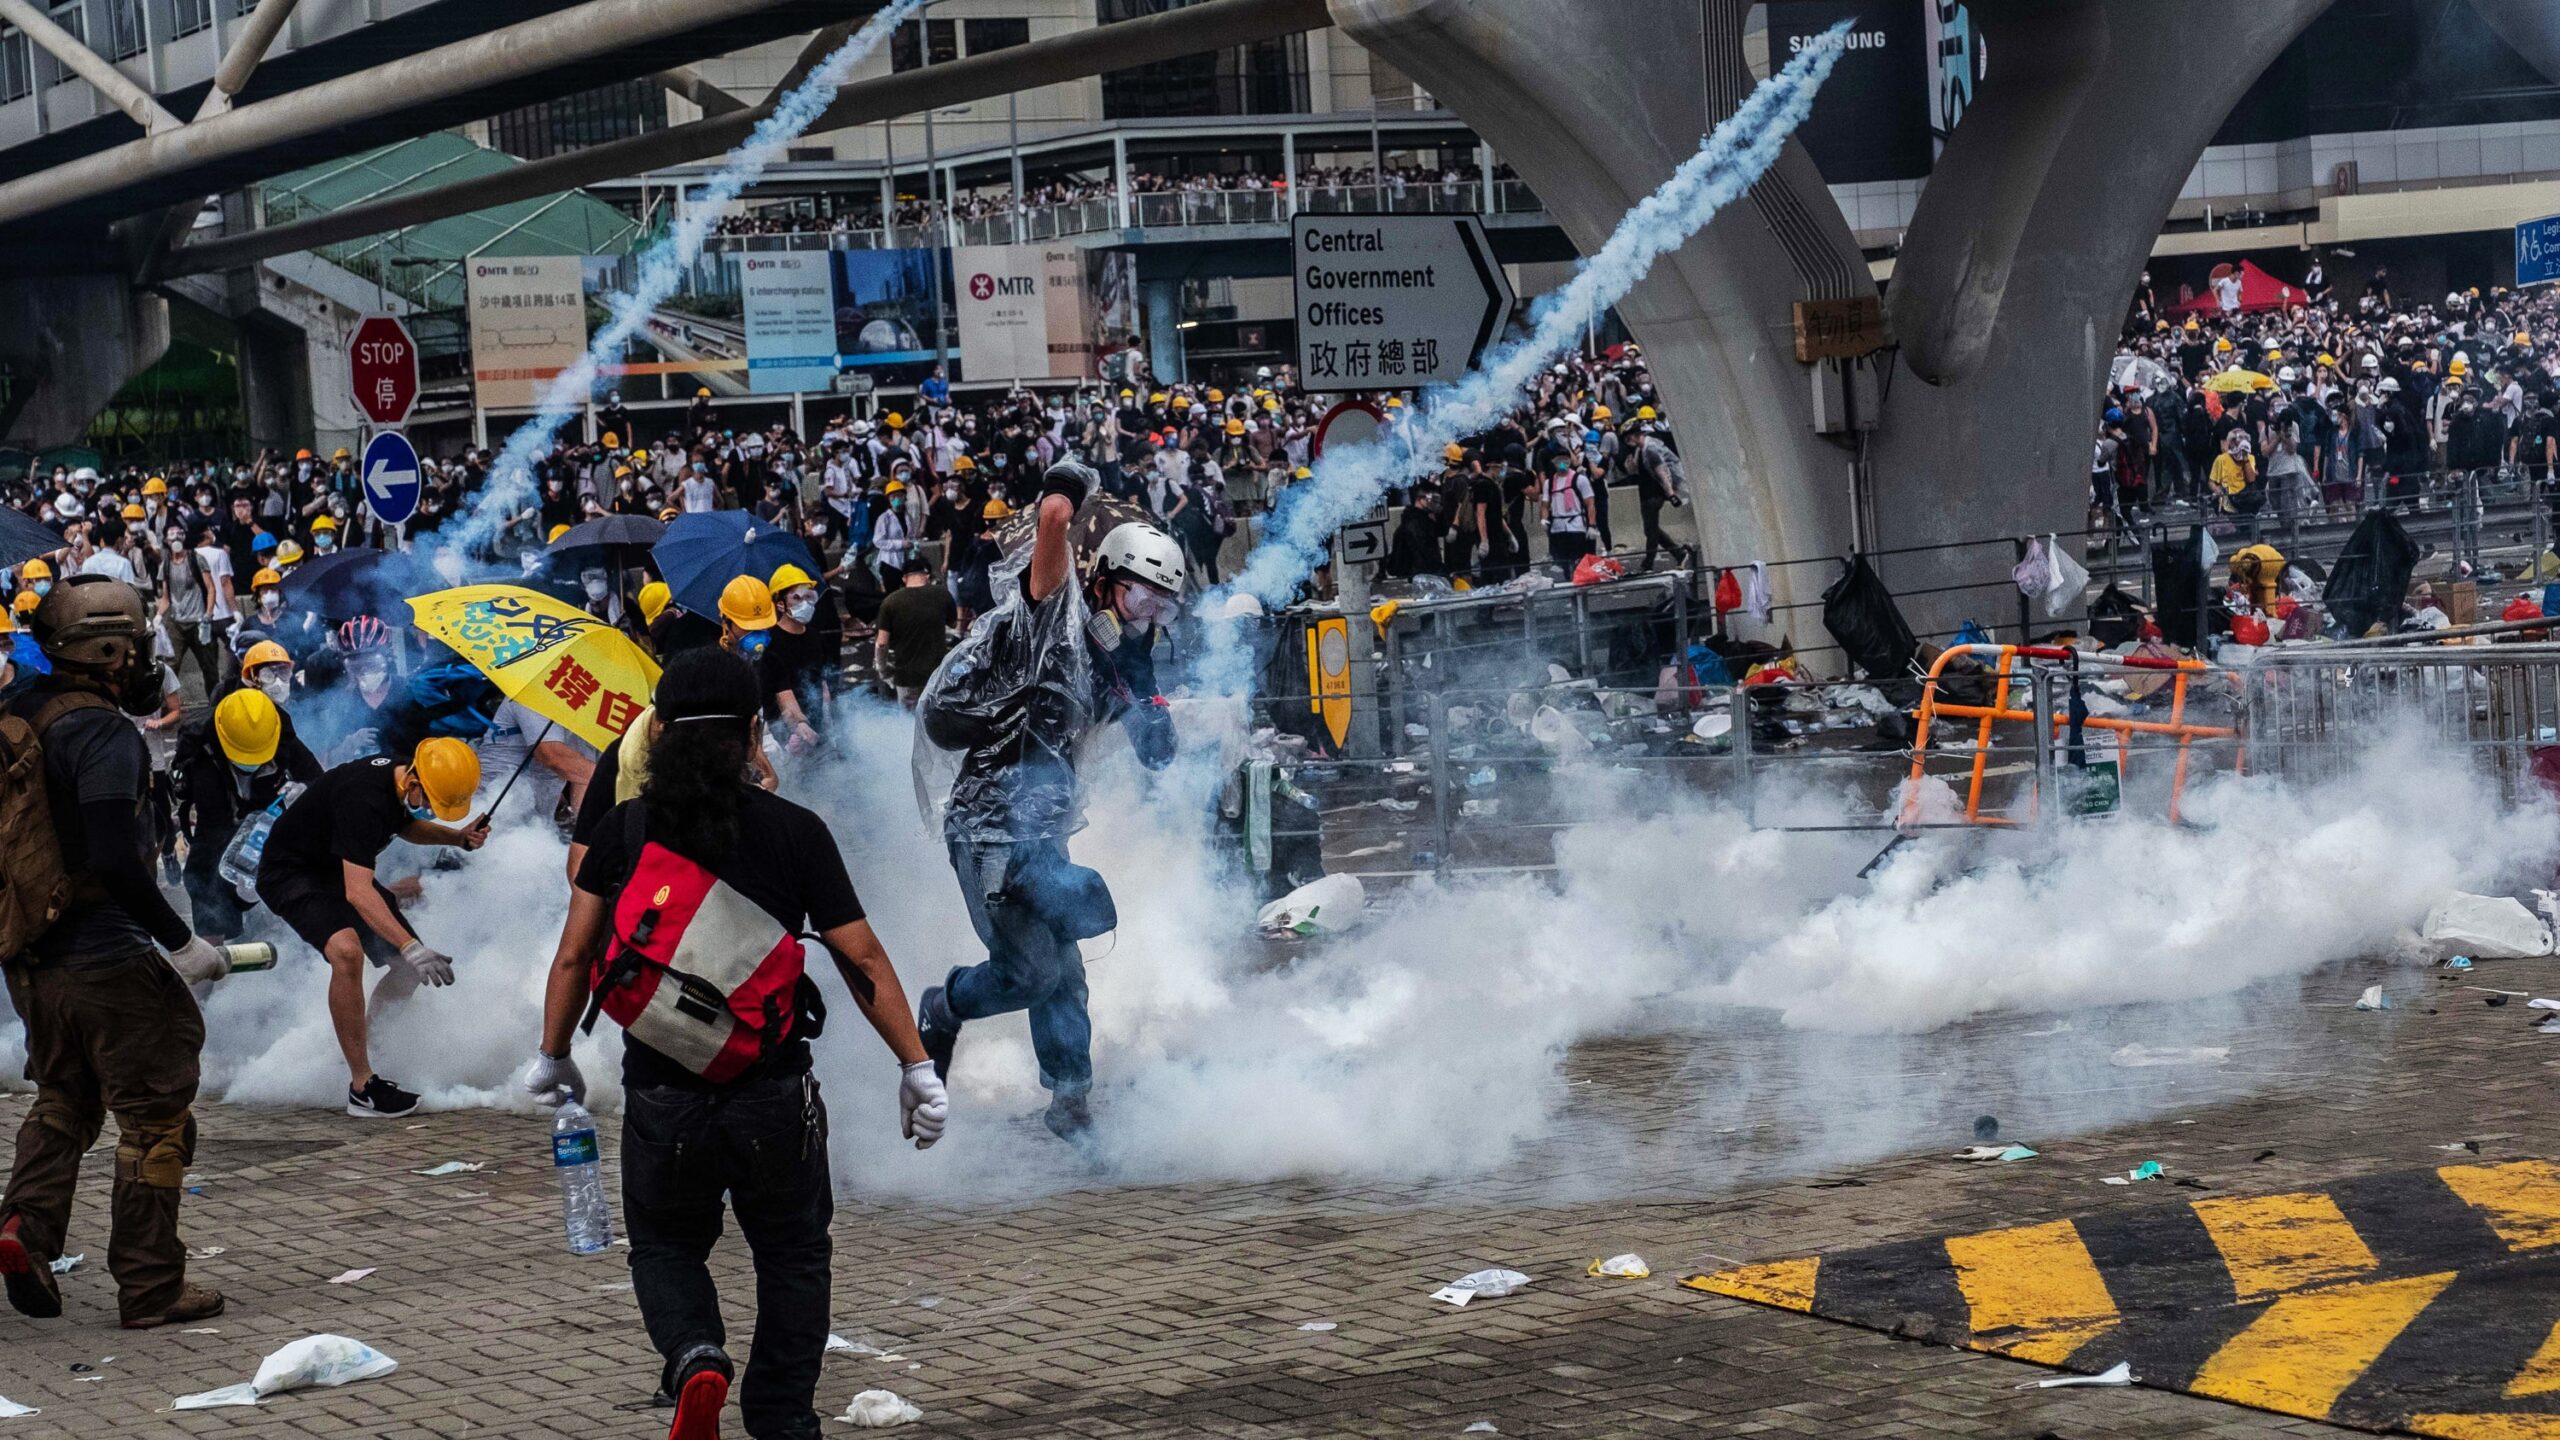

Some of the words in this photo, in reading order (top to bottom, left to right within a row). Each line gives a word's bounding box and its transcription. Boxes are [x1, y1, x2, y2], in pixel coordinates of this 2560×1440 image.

[1304, 228, 1384, 252] Central
[2543, 221, 2560, 236] Legi
[487, 266, 508, 275] MTR
[757, 260, 776, 269] MTR
[997, 277, 1035, 295] MTR
[1306, 264, 1435, 290] Government
[1307, 302, 1384, 326] Offices
[361, 342, 404, 365] STOP
[1309, 338, 1440, 378] 政府總部
[375, 377, 397, 411] 停
